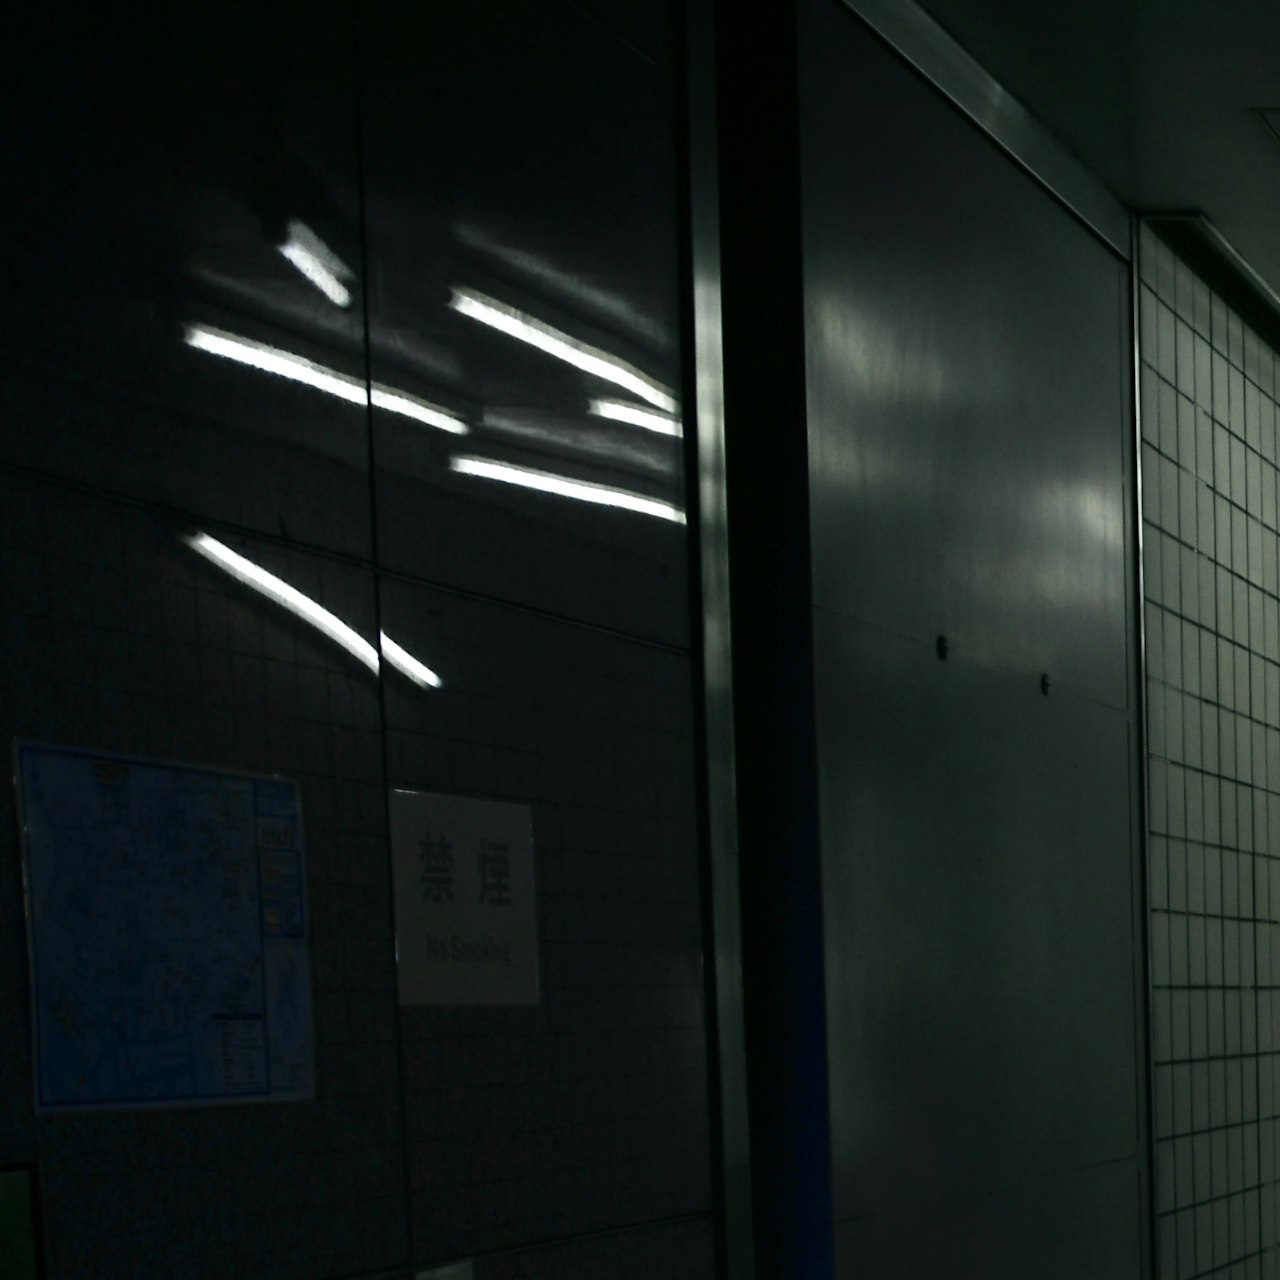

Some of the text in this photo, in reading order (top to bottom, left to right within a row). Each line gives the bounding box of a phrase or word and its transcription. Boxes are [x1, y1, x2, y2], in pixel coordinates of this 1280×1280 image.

[417, 831, 513, 906] 禁煙
[426, 934, 512, 967] No Smoking
